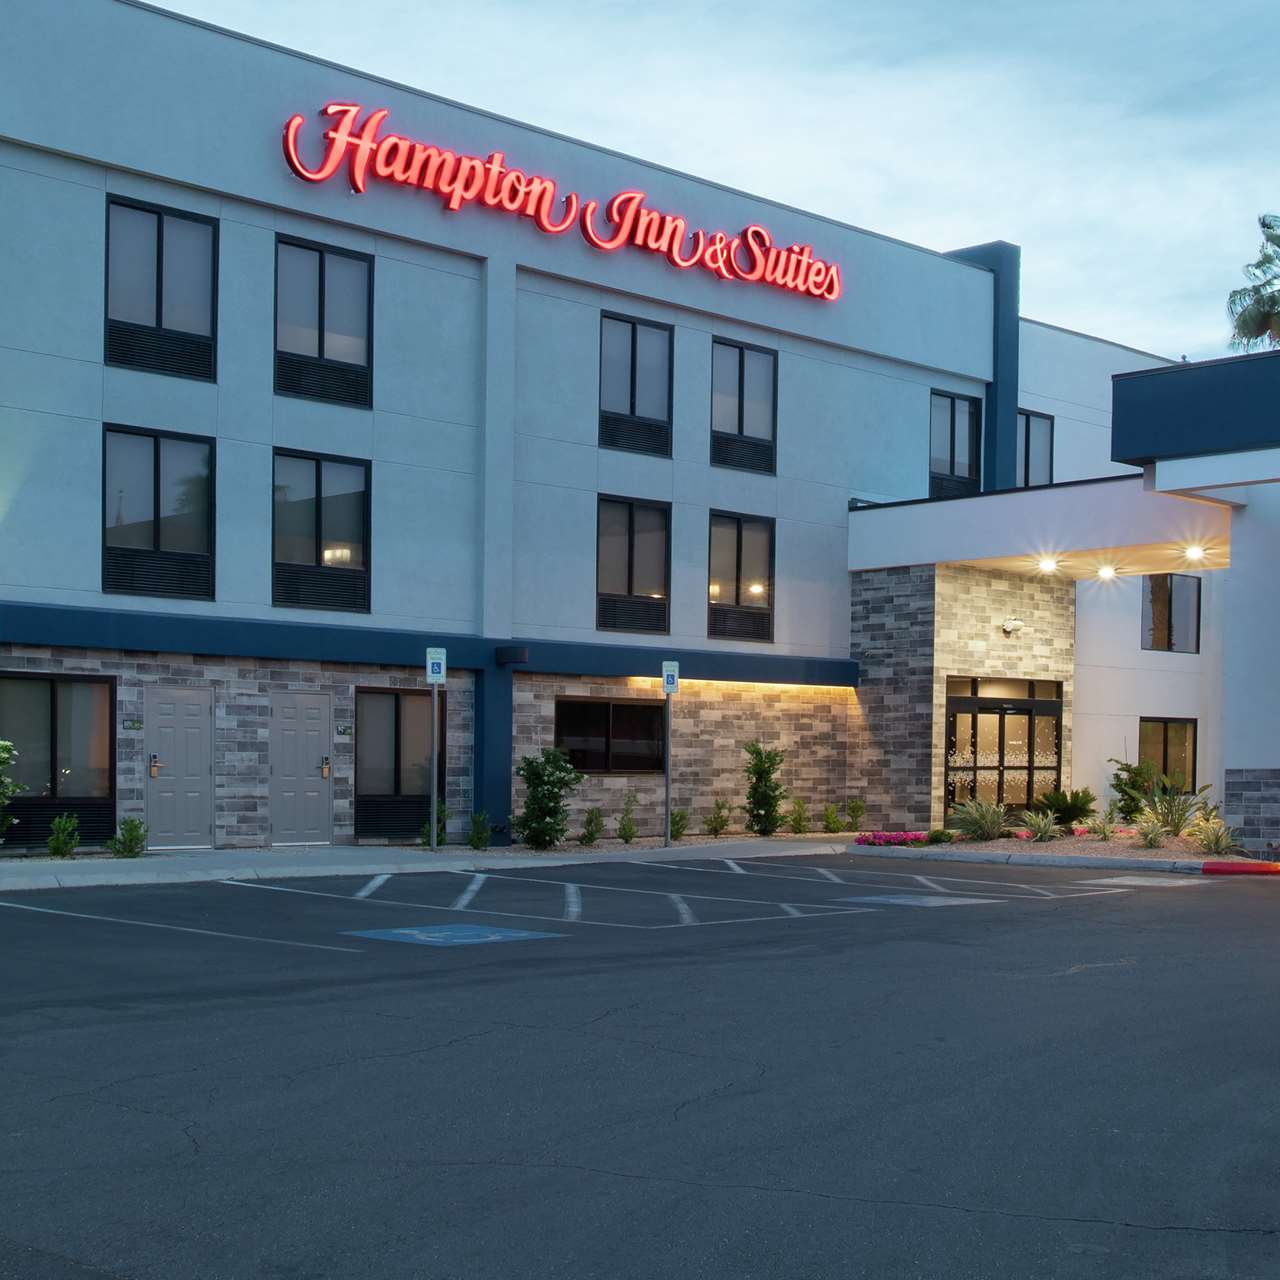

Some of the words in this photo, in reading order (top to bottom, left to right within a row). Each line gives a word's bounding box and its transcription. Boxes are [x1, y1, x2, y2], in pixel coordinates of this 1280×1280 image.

[282, 104, 577, 234] Hampton
[581, 191, 703, 267] Inn
[703, 231, 734, 280] &
[730, 223, 841, 300] Suites
